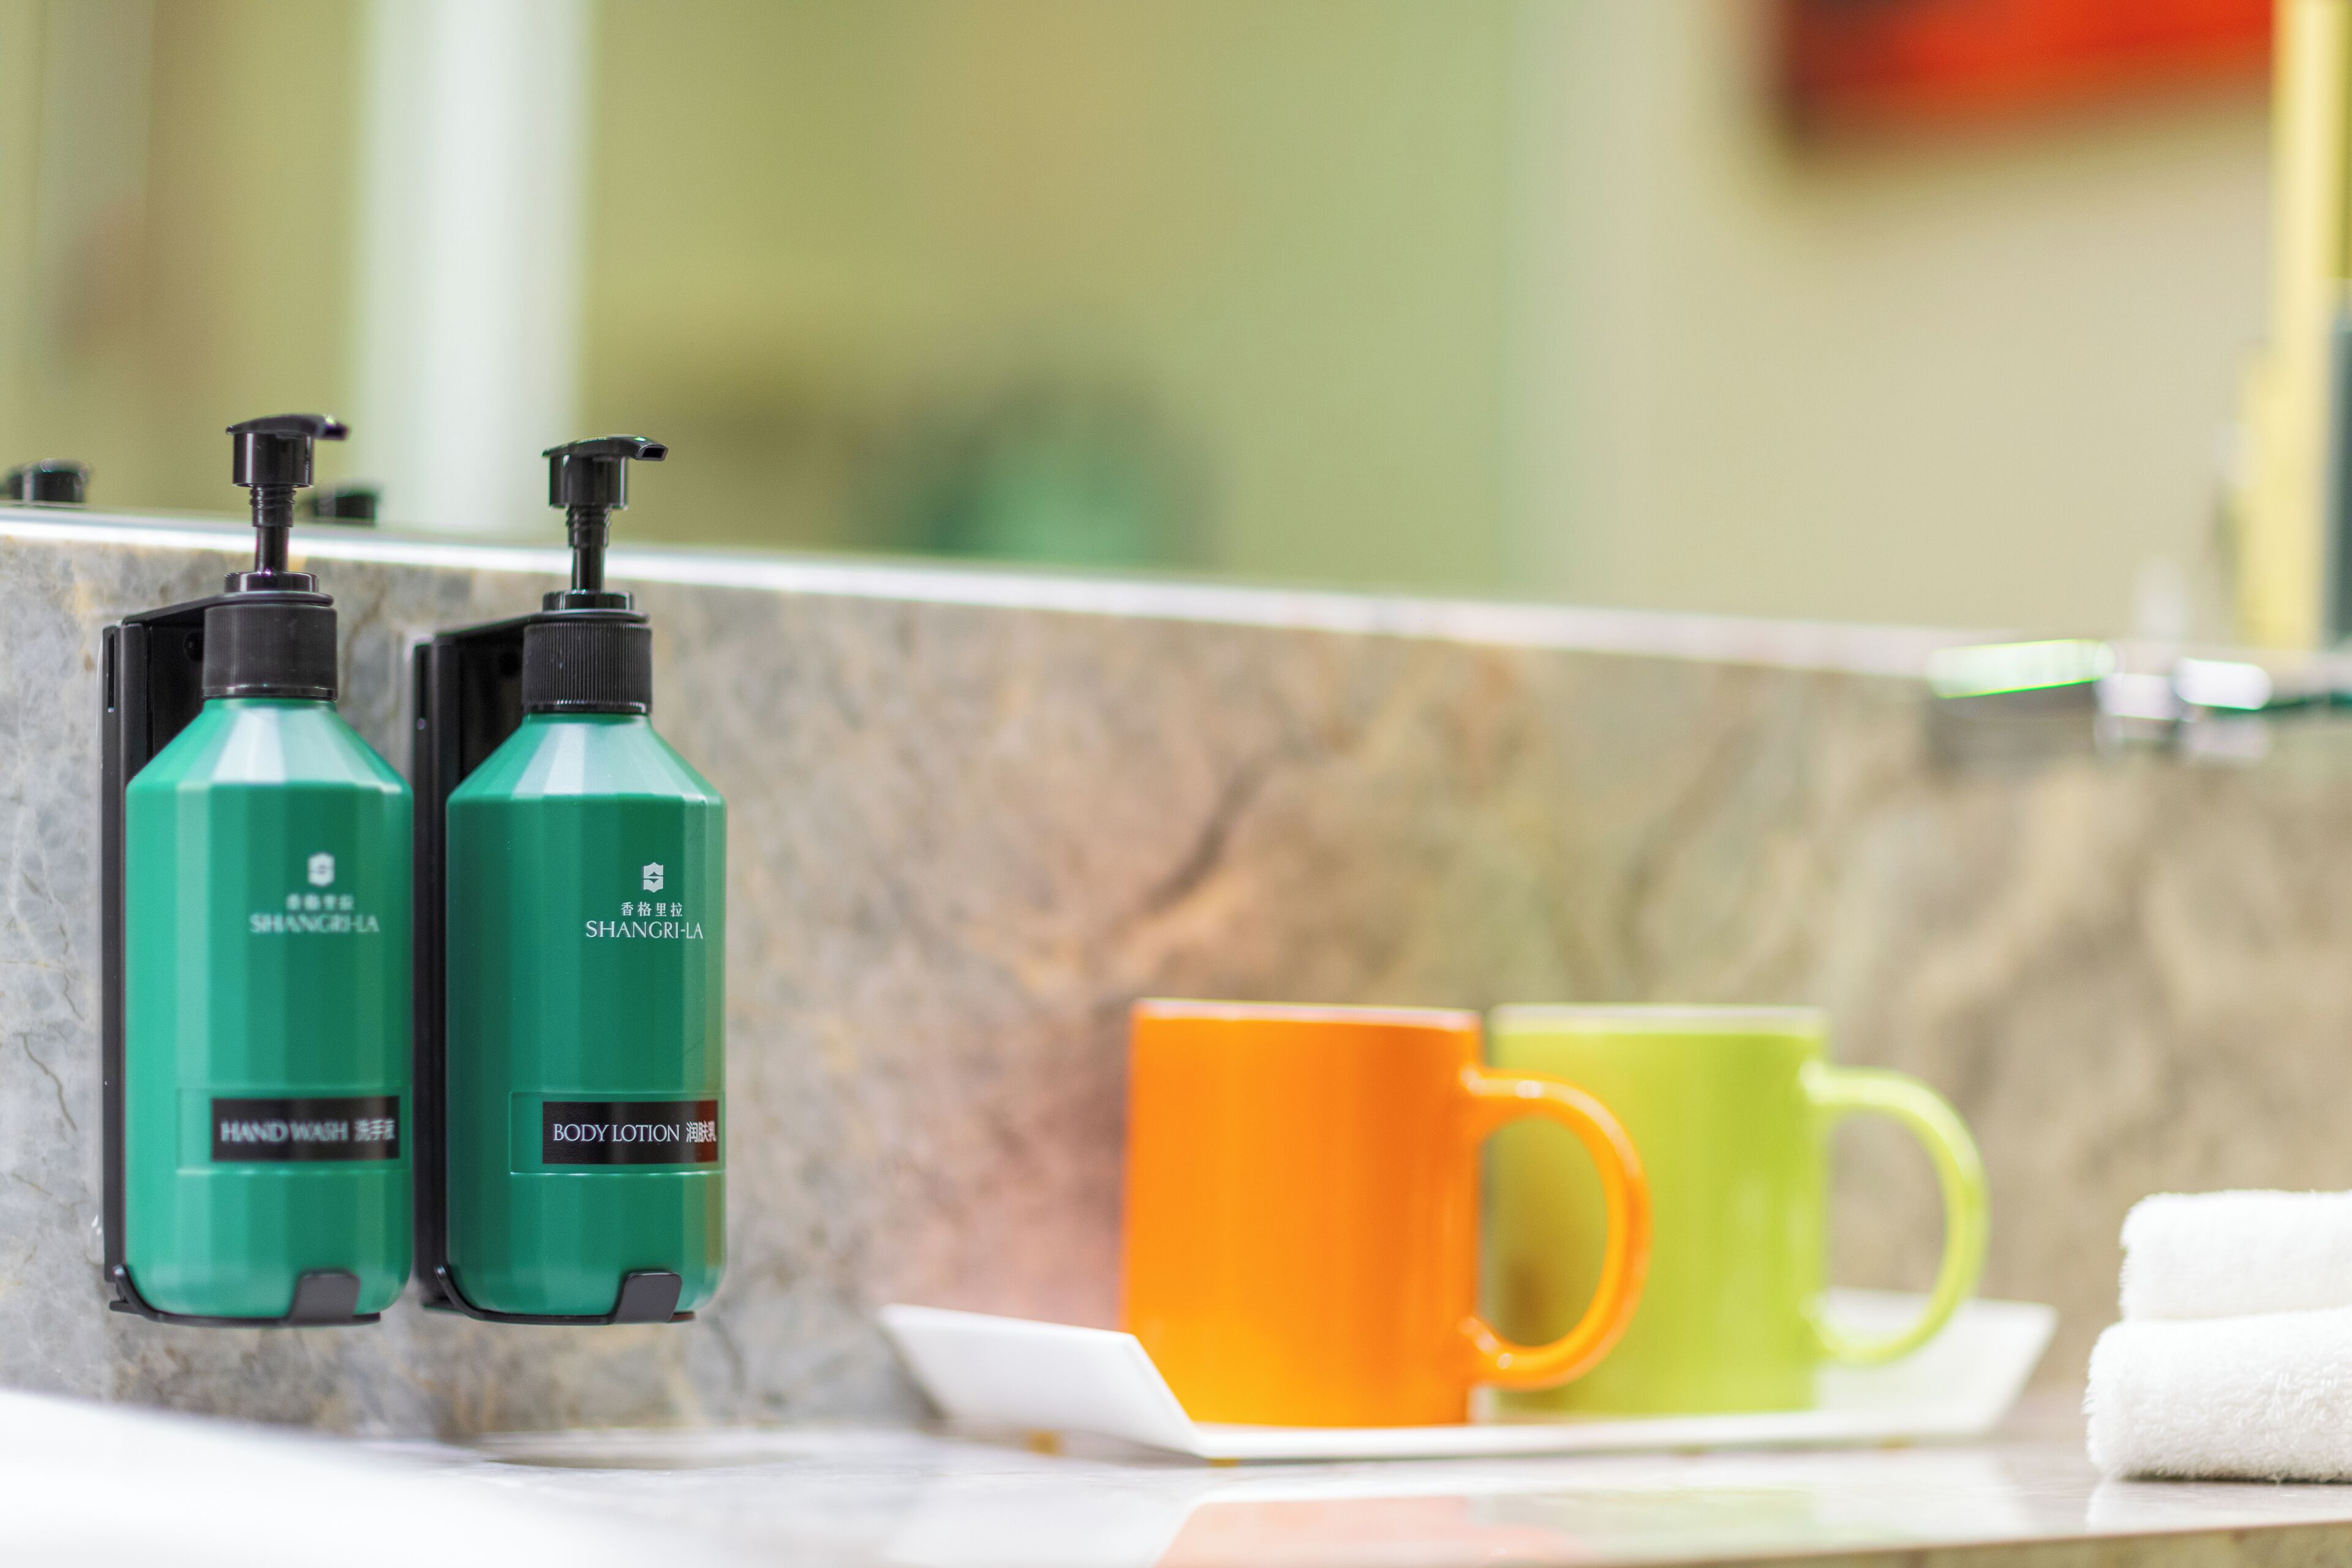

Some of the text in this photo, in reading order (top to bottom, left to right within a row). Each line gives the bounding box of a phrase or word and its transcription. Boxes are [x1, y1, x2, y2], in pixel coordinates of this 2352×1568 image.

[621, 902, 683, 917] 香格里拉
[249, 913, 380, 933] SHANGRI-LA
[586, 921, 704, 940] SHANGRI-LA
[221, 1120, 288, 1142] HAND
[289, 1120, 349, 1142] WASH
[554, 1124, 610, 1142] BODY
[612, 1124, 680, 1142] LOTION
